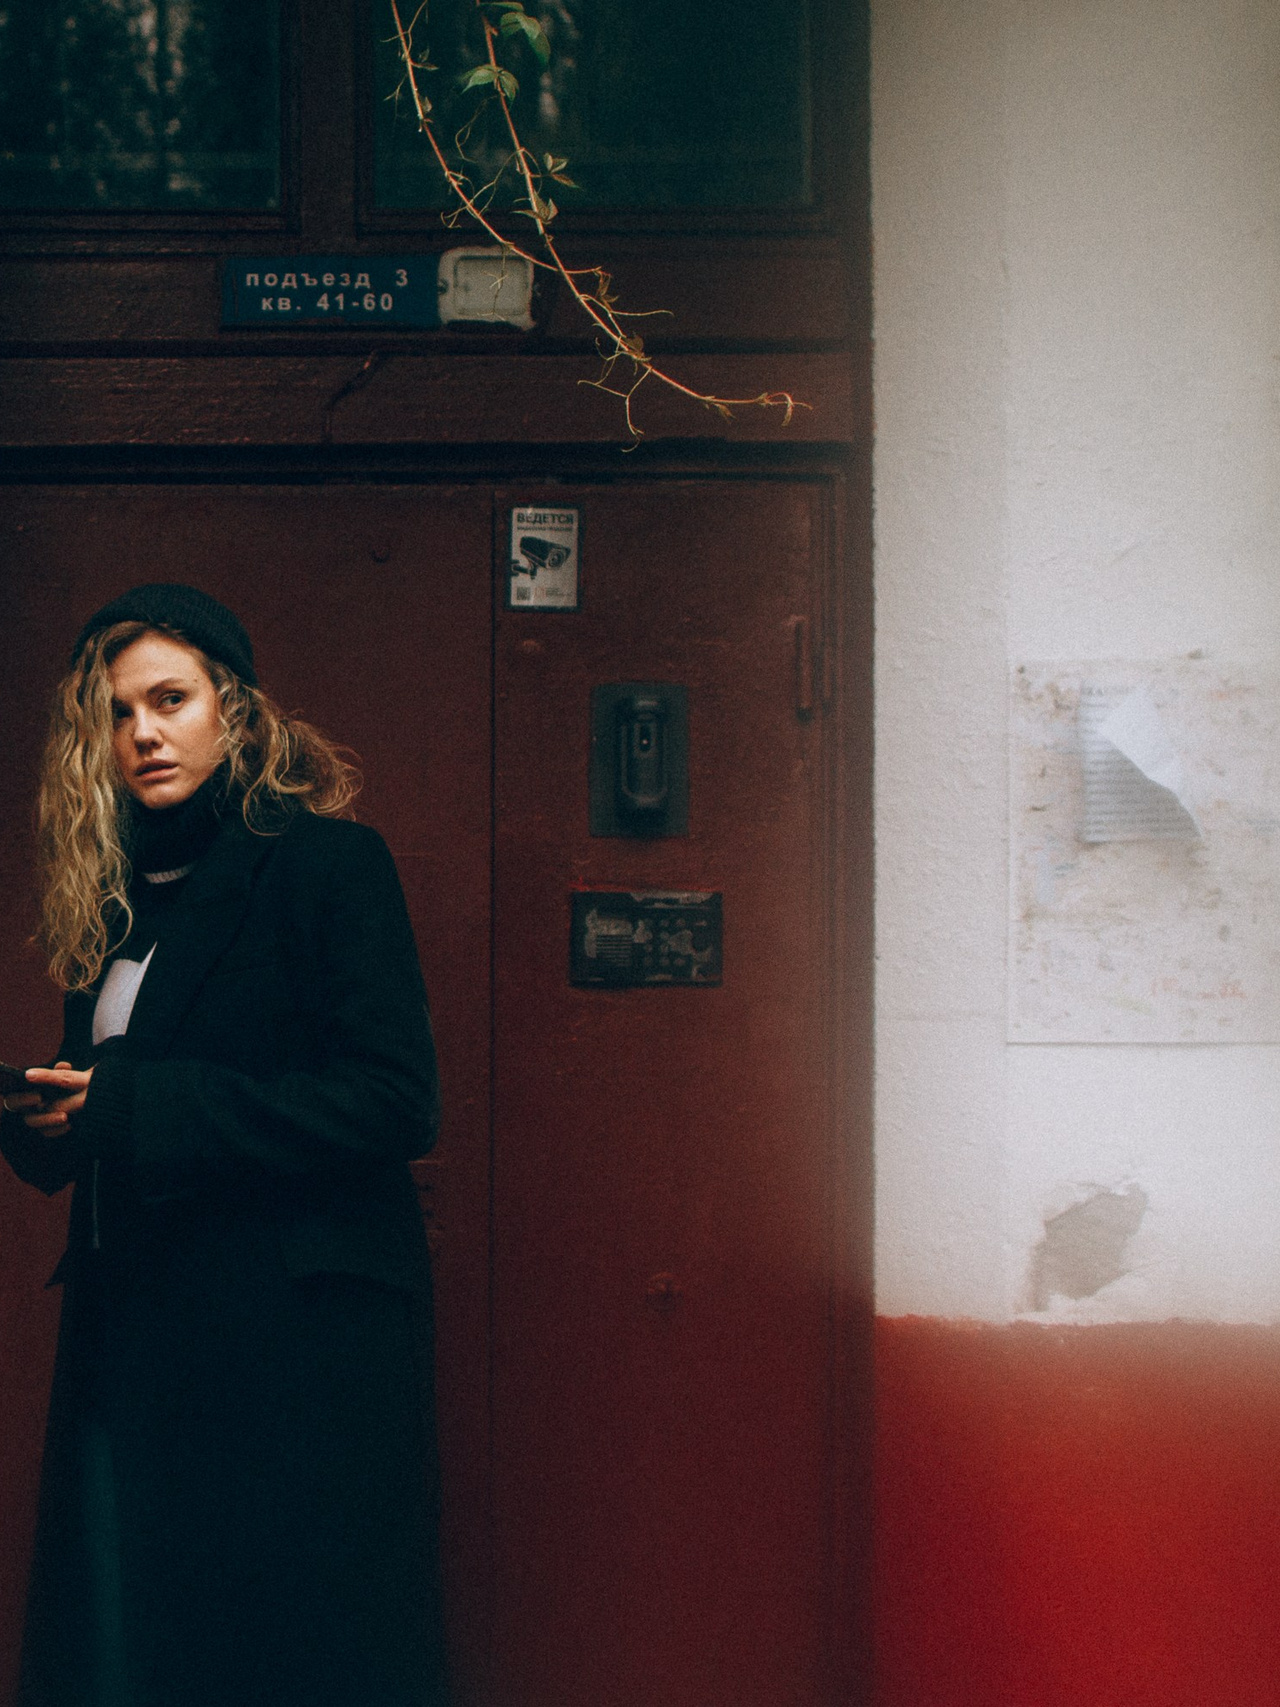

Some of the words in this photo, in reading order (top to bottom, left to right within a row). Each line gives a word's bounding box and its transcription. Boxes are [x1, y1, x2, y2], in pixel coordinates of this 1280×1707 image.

[245, 271, 372, 290] подъезд
[395, 268, 409, 287] 3
[260, 296, 303, 312] кв.
[316, 292, 393, 312] 41-60
[516, 512, 574, 524] ВЕДЕТСЯ
